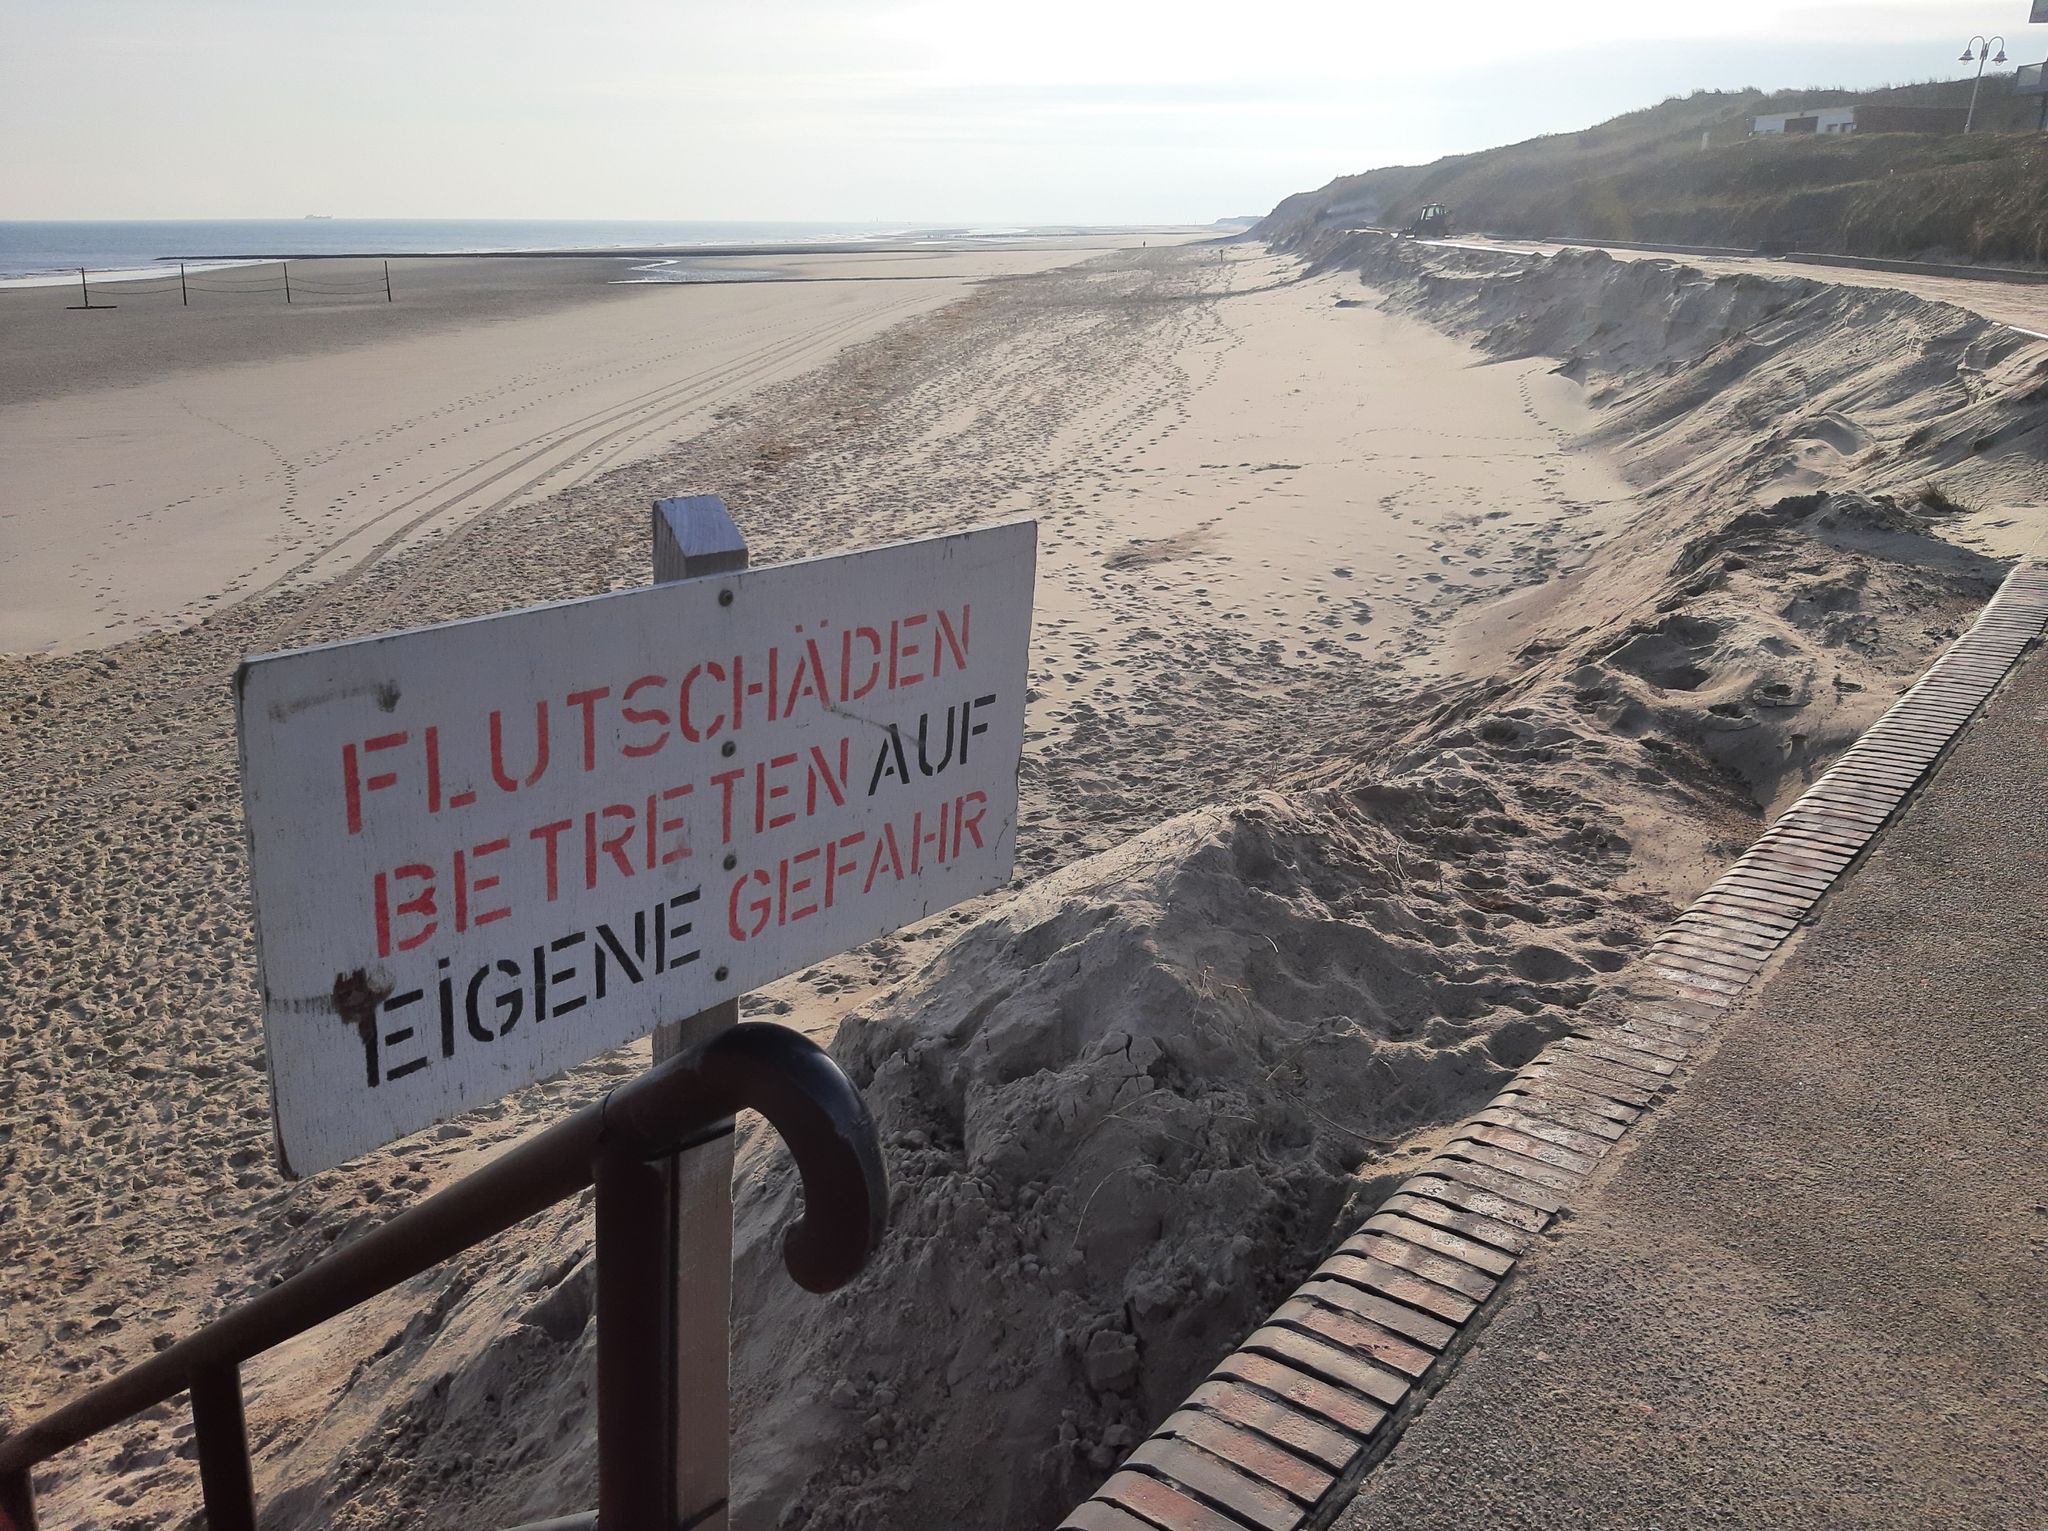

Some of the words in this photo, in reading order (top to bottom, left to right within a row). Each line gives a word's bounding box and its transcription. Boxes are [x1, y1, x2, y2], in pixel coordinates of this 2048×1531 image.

[343, 604, 971, 834] FLUTSCHÄDEN
[373, 737, 850, 958] BETRETEN
[868, 693, 997, 796] AUF
[728, 790, 988, 942] GEFAHR
